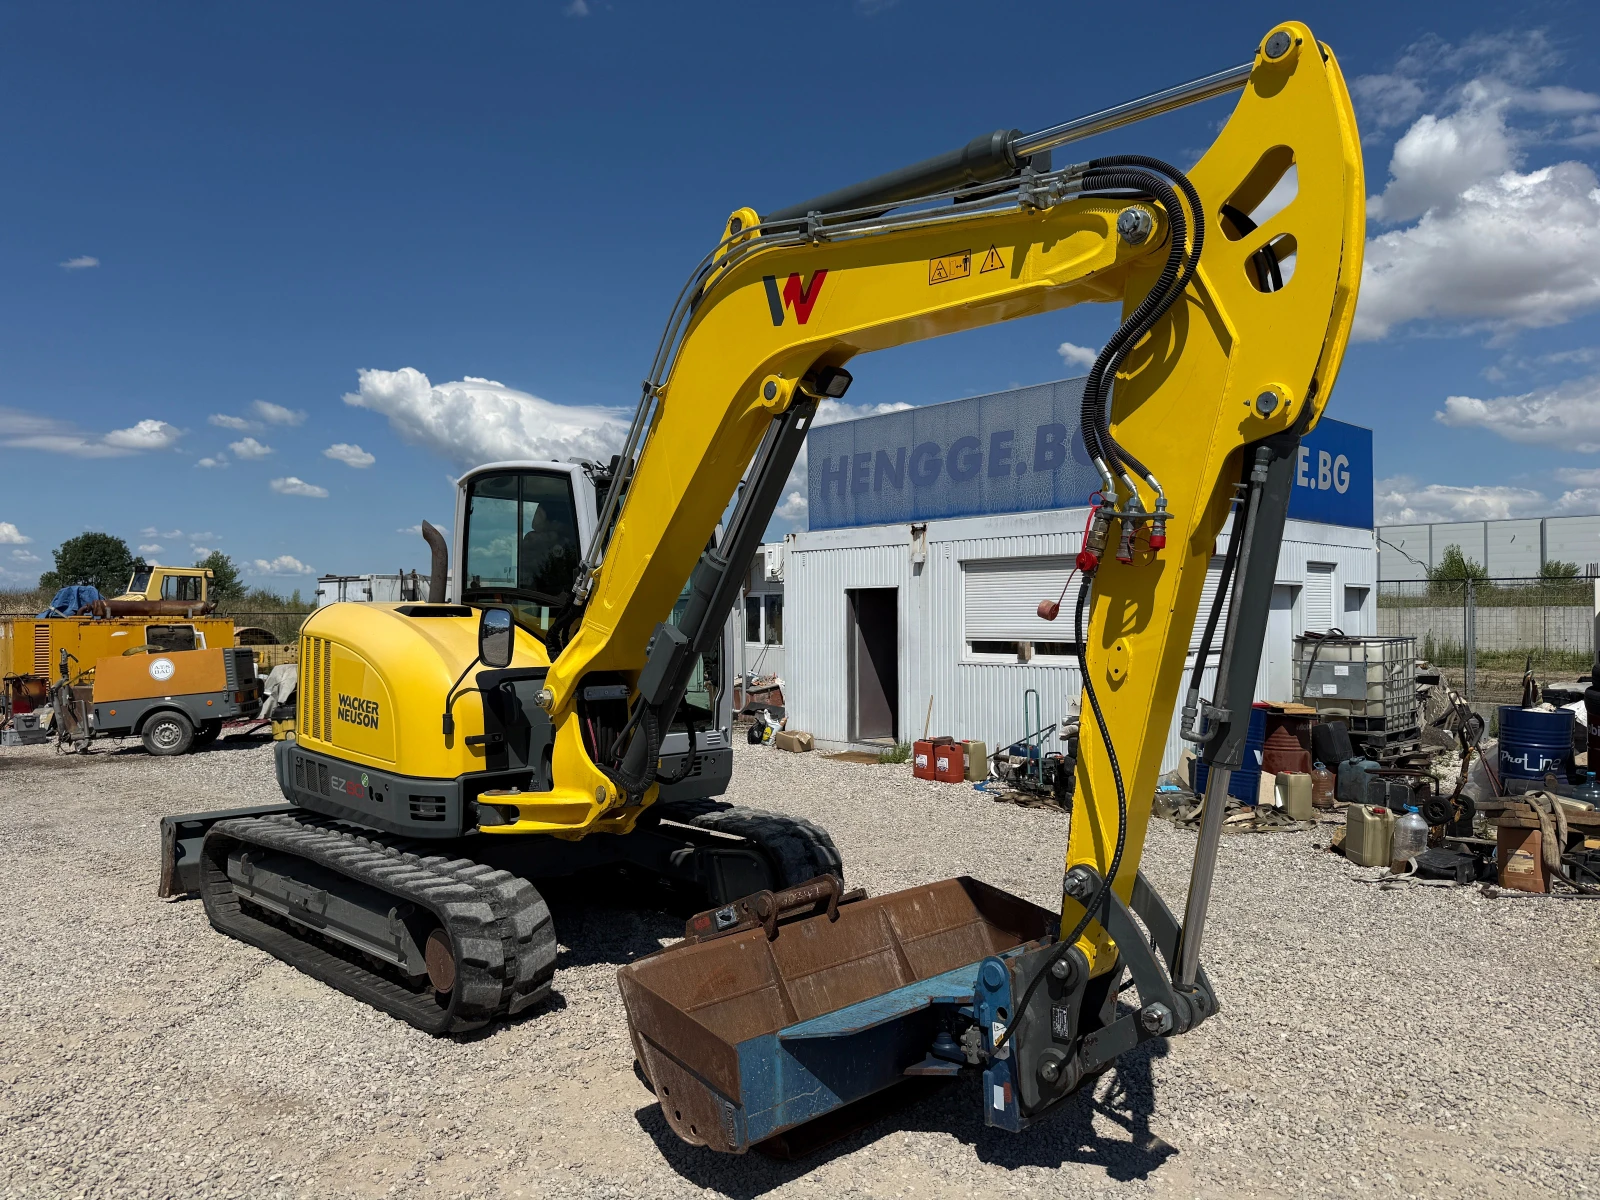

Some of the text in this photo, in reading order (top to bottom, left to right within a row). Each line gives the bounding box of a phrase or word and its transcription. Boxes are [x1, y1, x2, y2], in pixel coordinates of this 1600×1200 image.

[1296, 445, 1350, 494] E.BG
[338, 692, 379, 716] WACKER
[337, 706, 379, 730] NEUSON
[331, 775, 365, 799] EZ80
